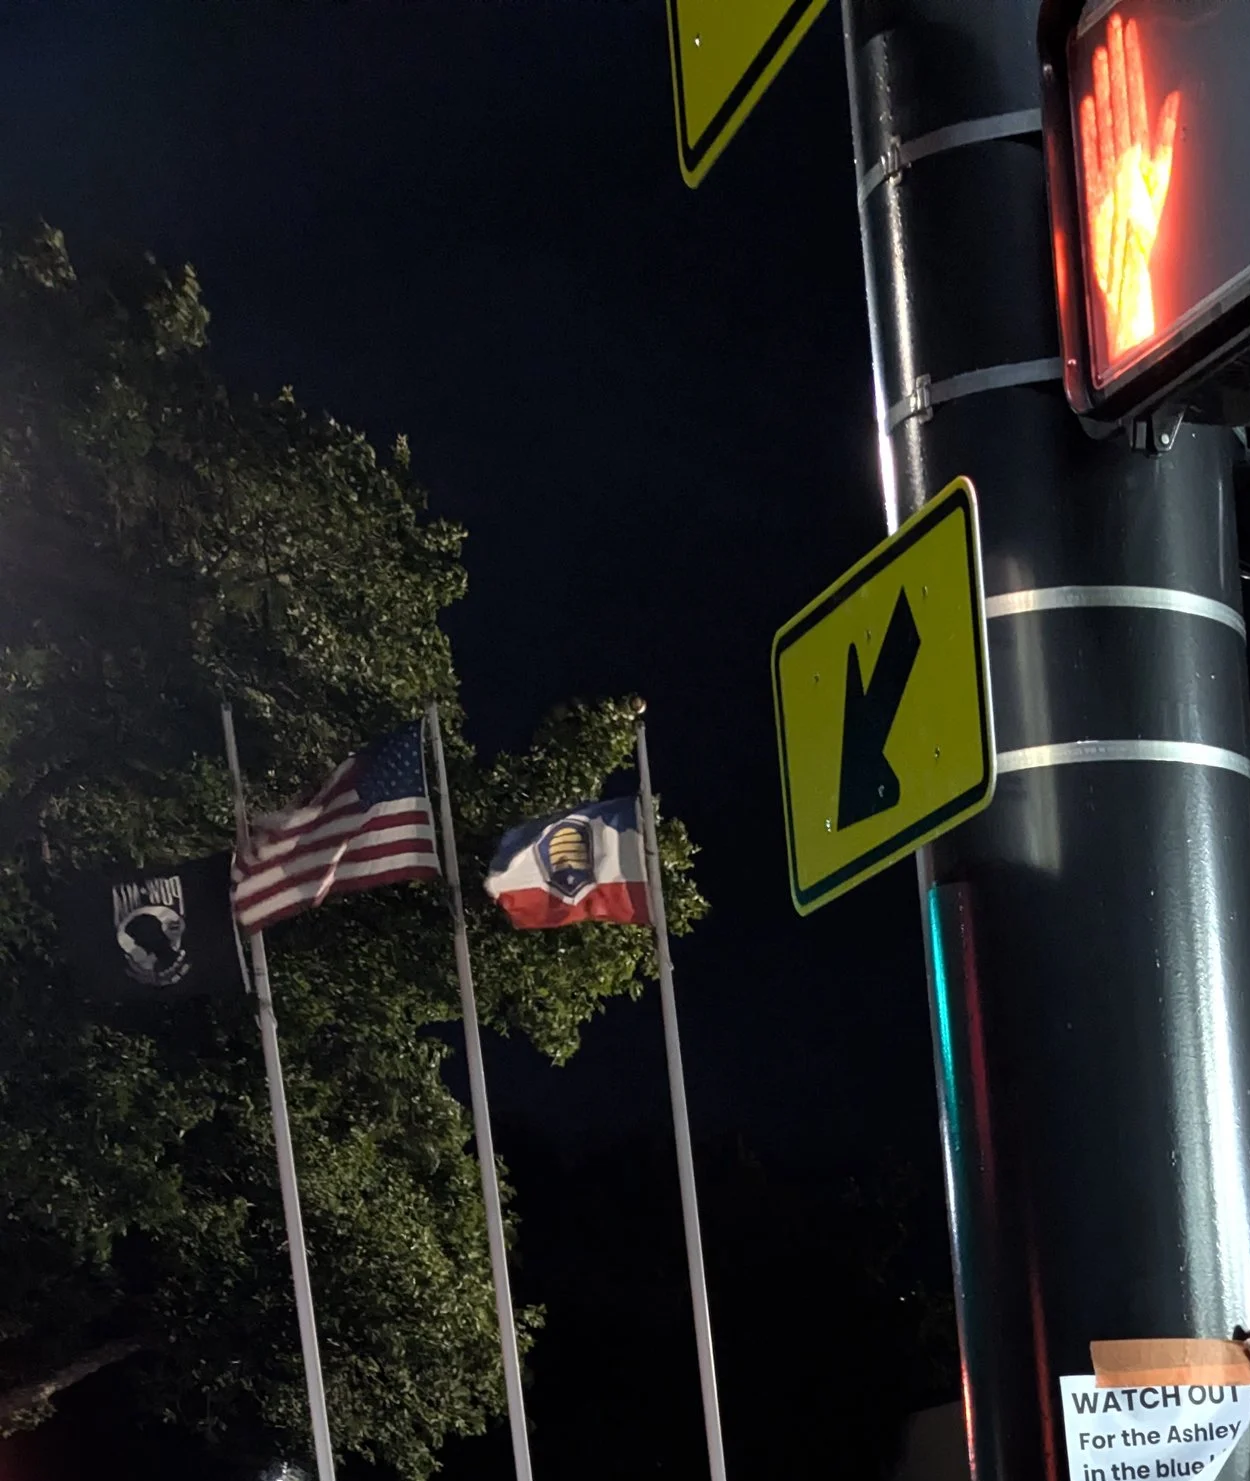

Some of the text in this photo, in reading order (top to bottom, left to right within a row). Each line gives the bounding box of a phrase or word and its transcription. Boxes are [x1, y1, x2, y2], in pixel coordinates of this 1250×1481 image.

[1072, 1386, 1181, 1414] WATCH
[1079, 1420, 1242, 1450] For the Ashley
[1111, 1462, 1150, 1481] the
[1156, 1459, 1205, 1478] blue
